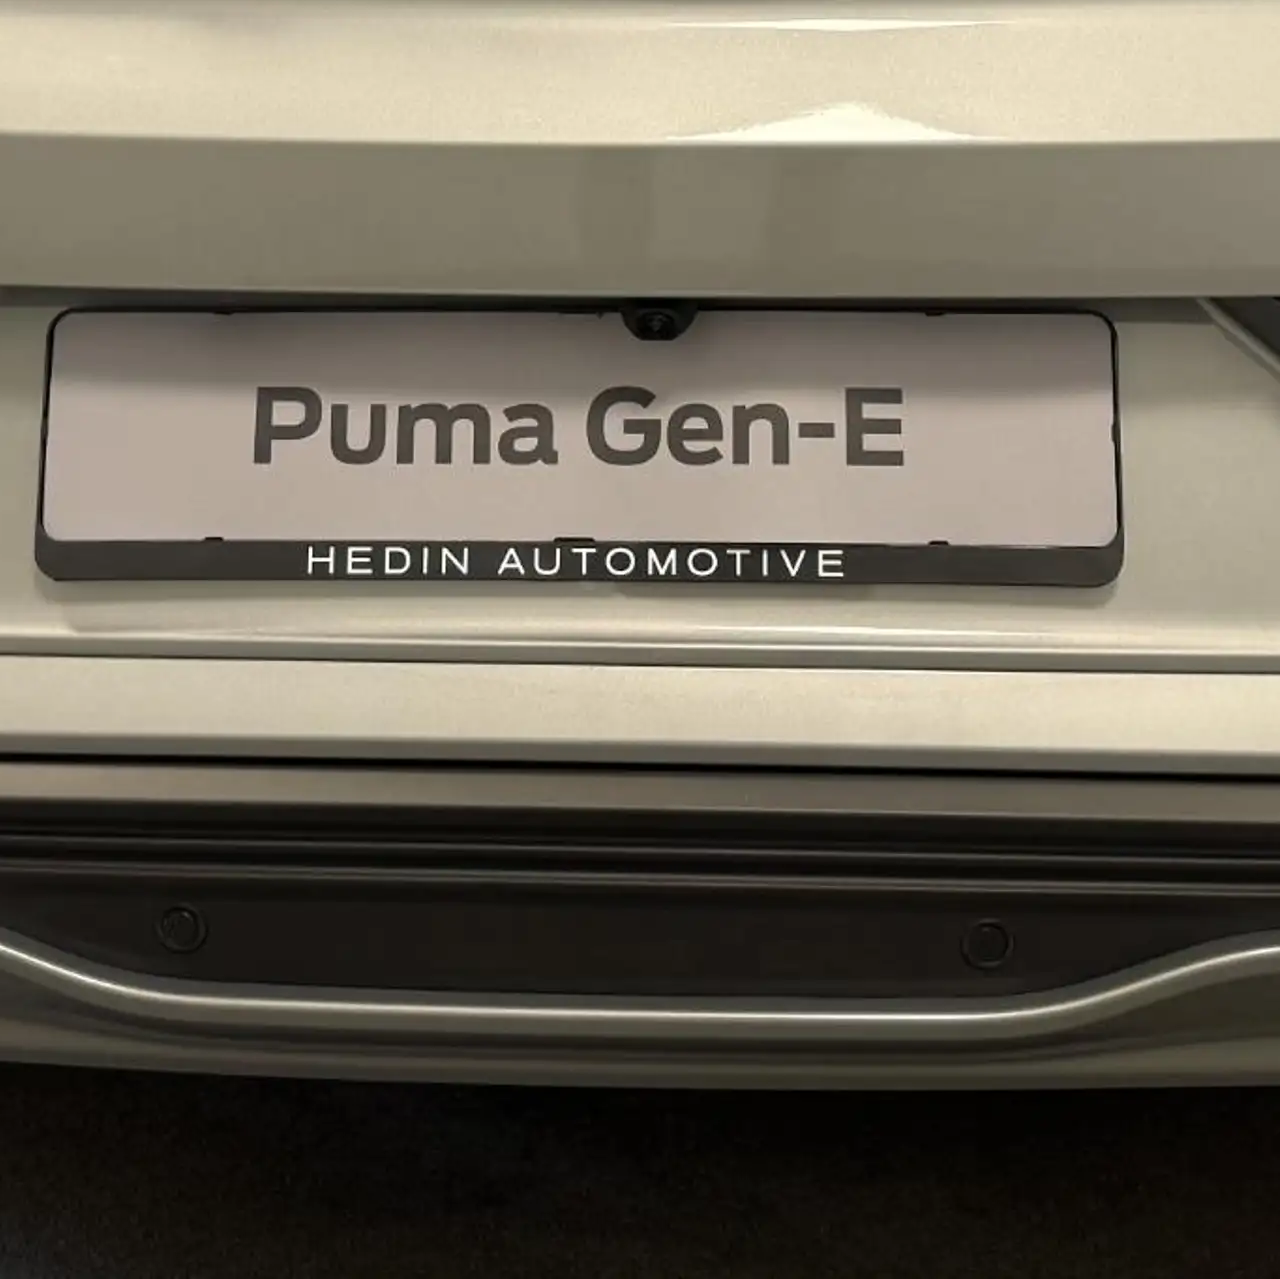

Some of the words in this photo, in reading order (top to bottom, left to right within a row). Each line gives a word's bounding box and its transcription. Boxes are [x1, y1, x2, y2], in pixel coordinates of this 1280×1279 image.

[253, 386, 559, 466] Puma
[585, 385, 904, 467] Gen-E
[307, 545, 472, 577] HEDIN
[497, 546, 847, 579] AUTOMOTIVE
